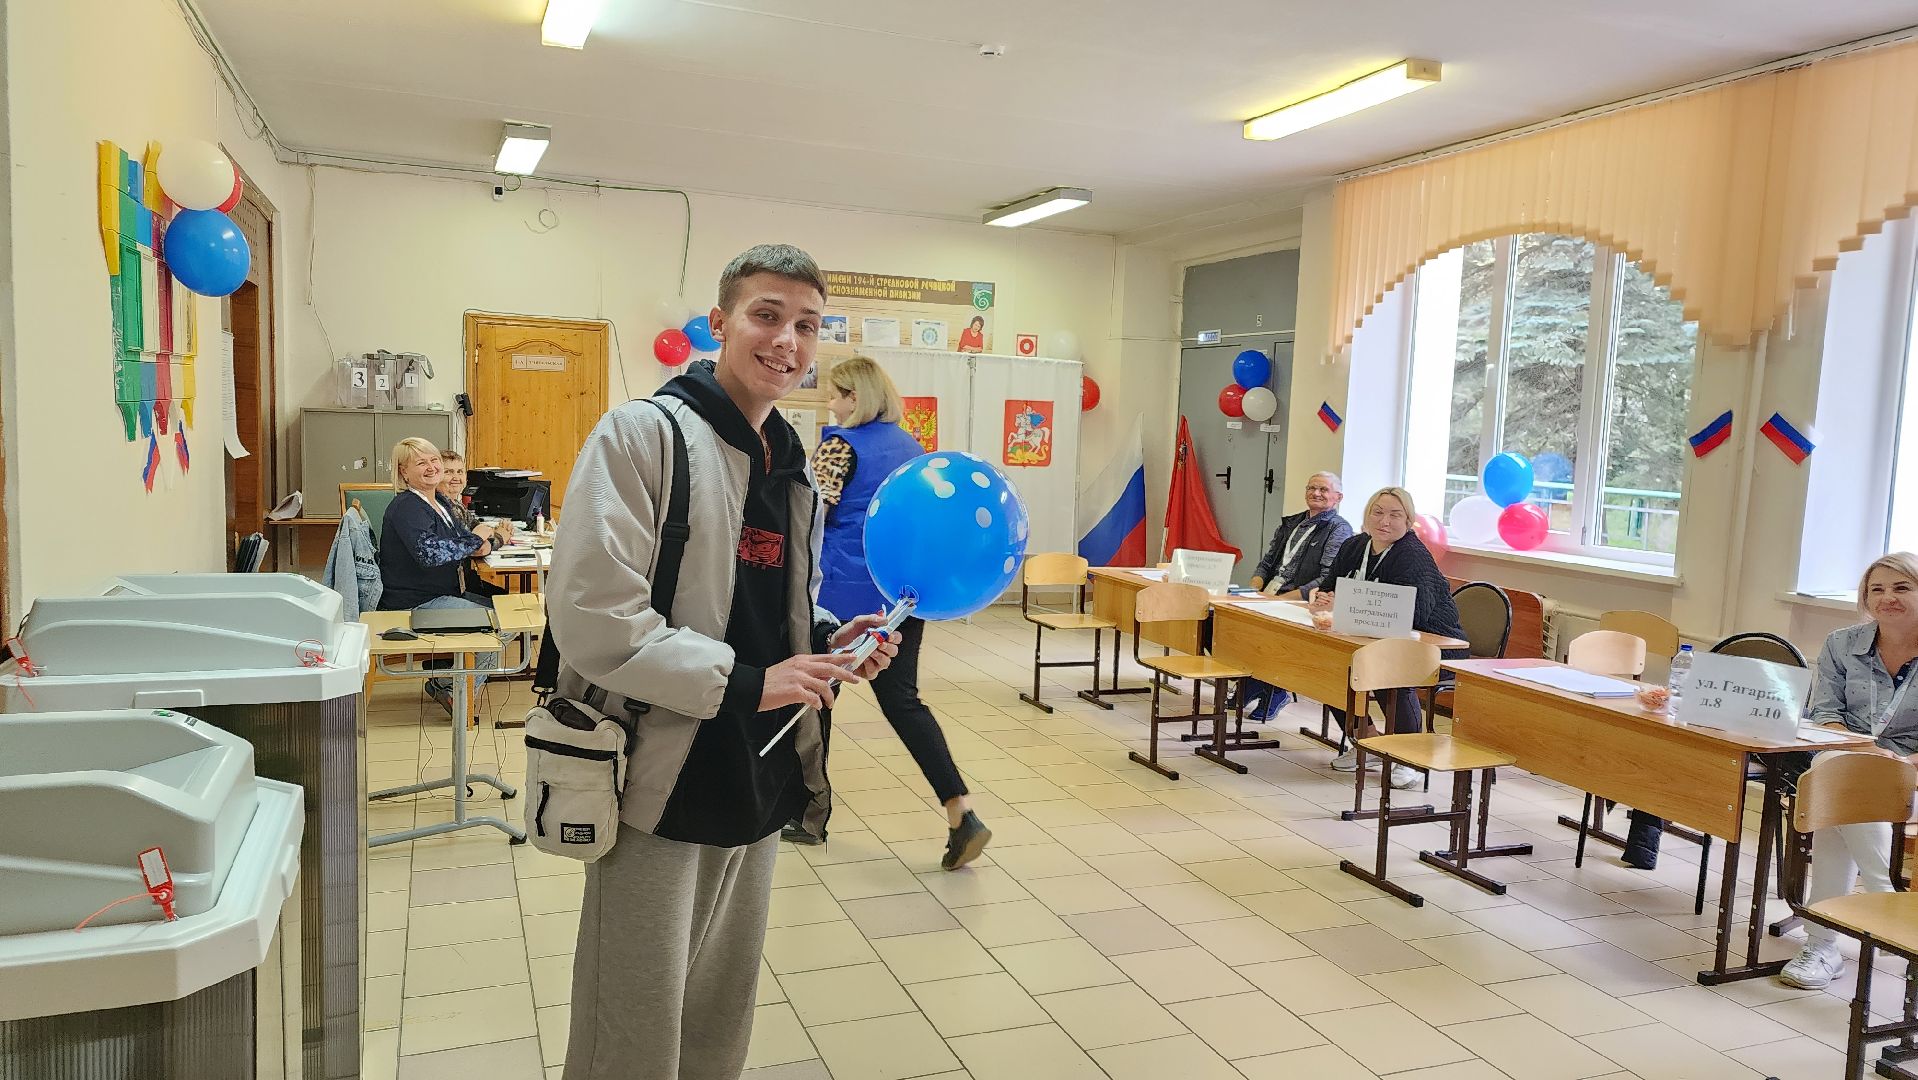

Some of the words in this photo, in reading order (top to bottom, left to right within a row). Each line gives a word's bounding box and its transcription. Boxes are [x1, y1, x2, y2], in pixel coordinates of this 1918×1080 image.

[827, 273, 851, 285] ИМЕНИ
[854, 275, 875, 287] 194-Й
[877, 277, 919, 290] СТРЕЛКОВОЙ
[353, 371, 365, 388] 3
[379, 378, 386, 388] 2
[409, 375, 414, 385] 1
[1695, 678, 1718, 690] ул.
[1699, 696, 1723, 709] д.8
[1749, 706, 1782, 720] д.10
